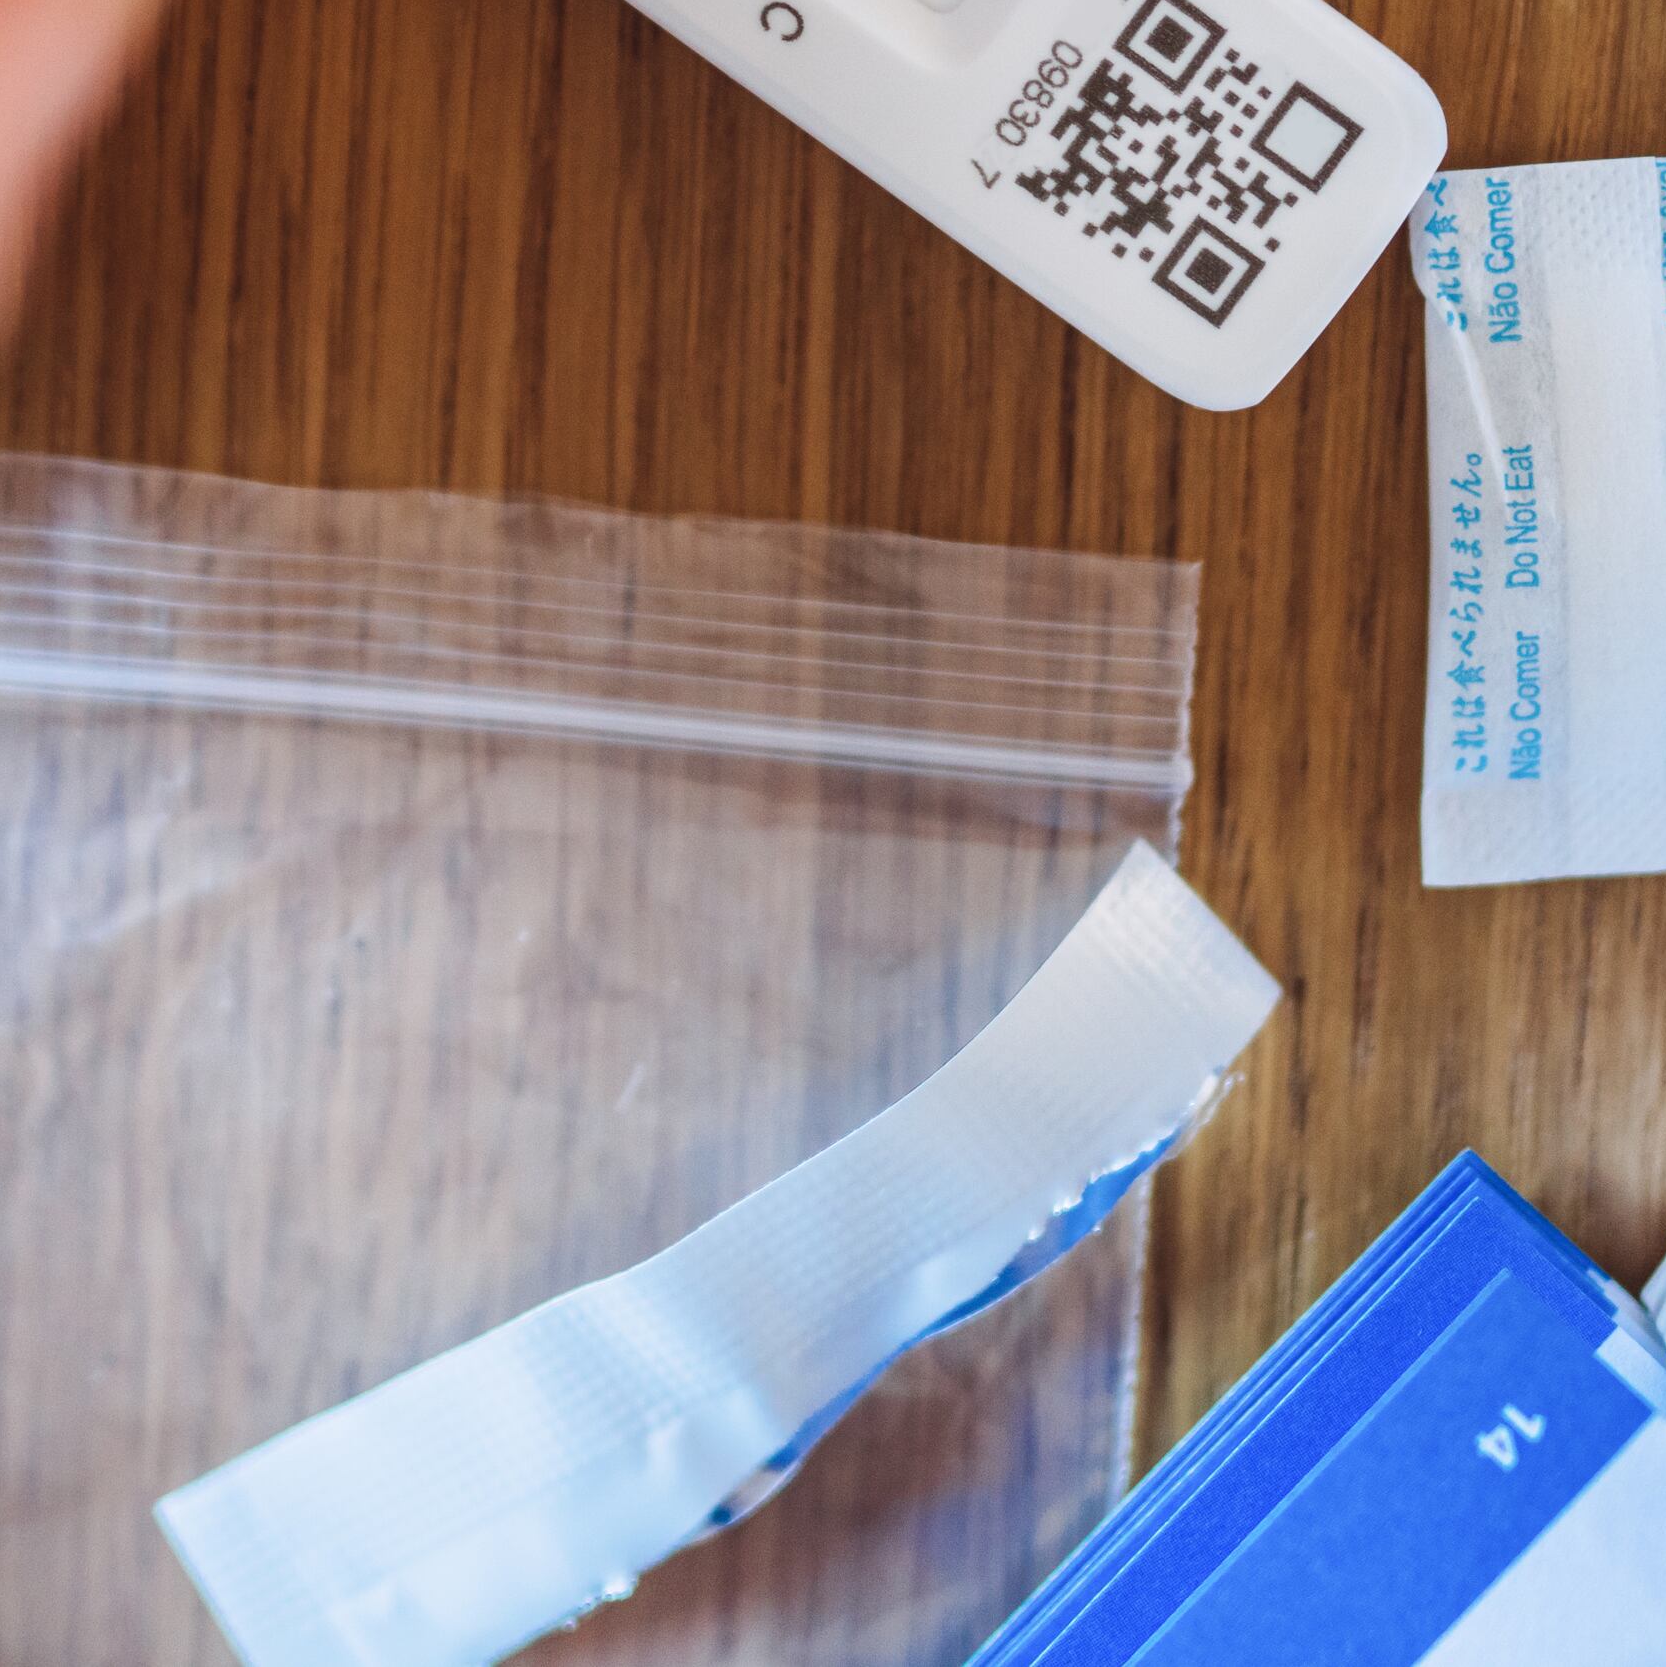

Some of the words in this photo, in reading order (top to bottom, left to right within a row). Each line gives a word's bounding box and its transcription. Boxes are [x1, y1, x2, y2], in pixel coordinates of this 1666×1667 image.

[759, 1, 805, 43] C
[995, 40, 1084, 147] 09830
[971, 159, 1002, 190] 7
[1483, 176, 1516, 275] Comer
[1488, 280, 1522, 344] Não
[1500, 445, 1535, 492] Eat
[1504, 498, 1539, 547] Not
[1504, 551, 1542, 589] Do
[1508, 630, 1542, 723] Comer
[1507, 727, 1543, 781] Não
[1478, 1407, 1543, 1467] 14
